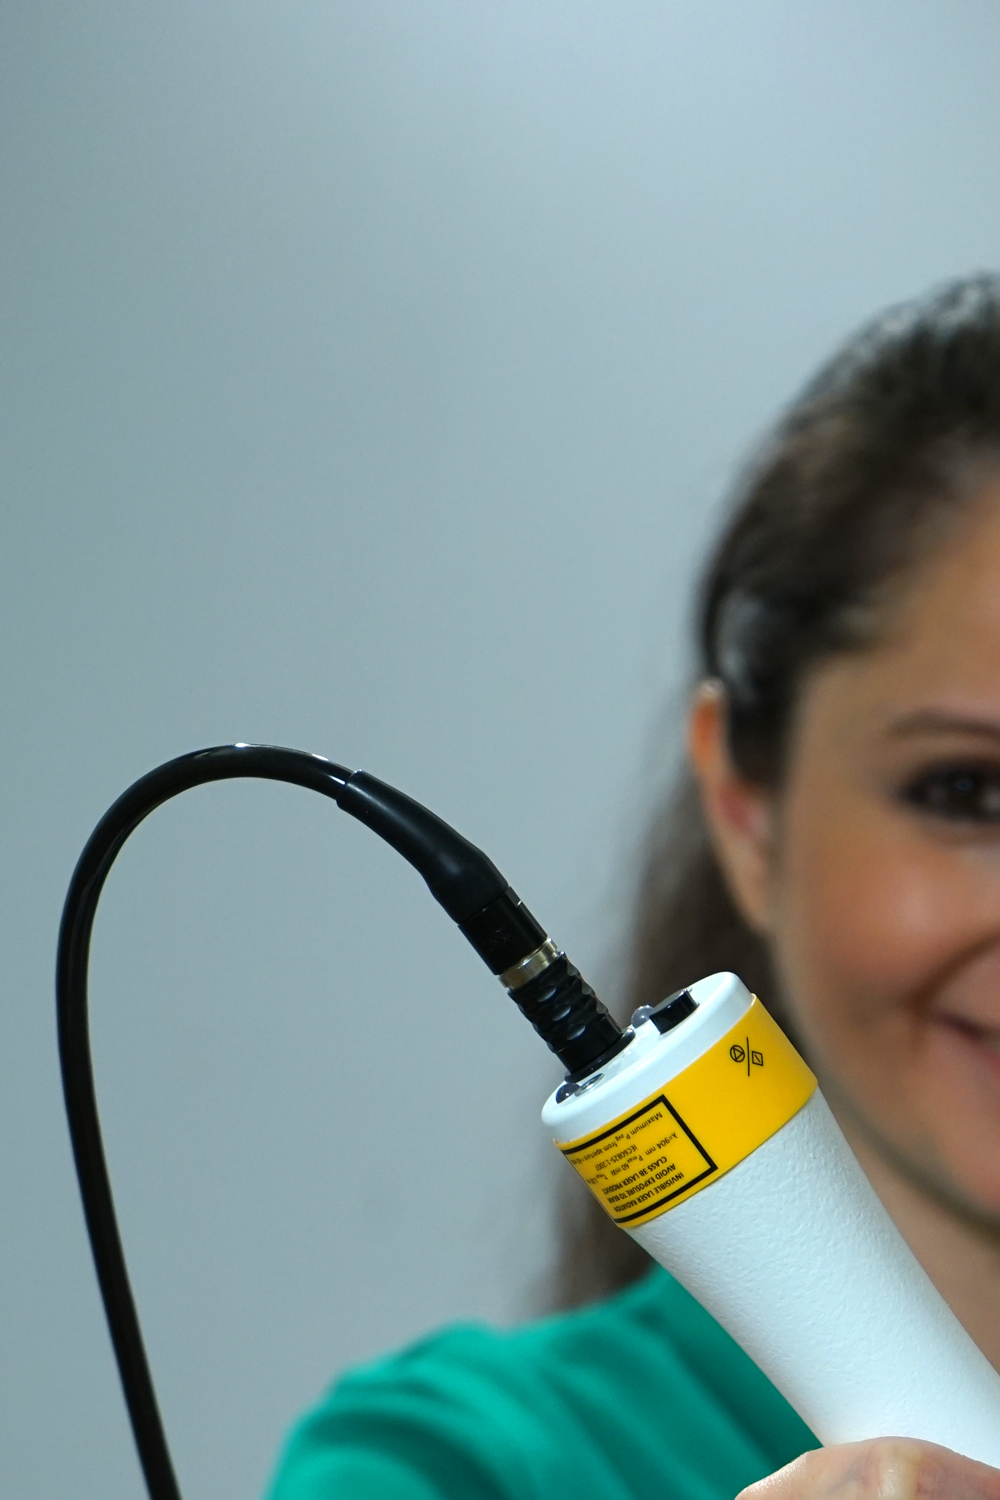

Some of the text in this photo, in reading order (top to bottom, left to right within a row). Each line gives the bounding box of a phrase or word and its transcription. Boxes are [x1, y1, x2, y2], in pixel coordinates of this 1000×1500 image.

[629, 1111, 663, 1136] Maximum
[602, 1141, 619, 1152] from
[638, 1167, 649, 1178] 3B
[646, 1156, 668, 1173] CLASS
[654, 1163, 677, 1181] AVOID
[620, 1172, 641, 1187] LASER
[625, 1176, 657, 1197] EXPOSURE
[653, 1171, 685, 1195] INVISIBLE
[635, 1189, 656, 1204] LASER
